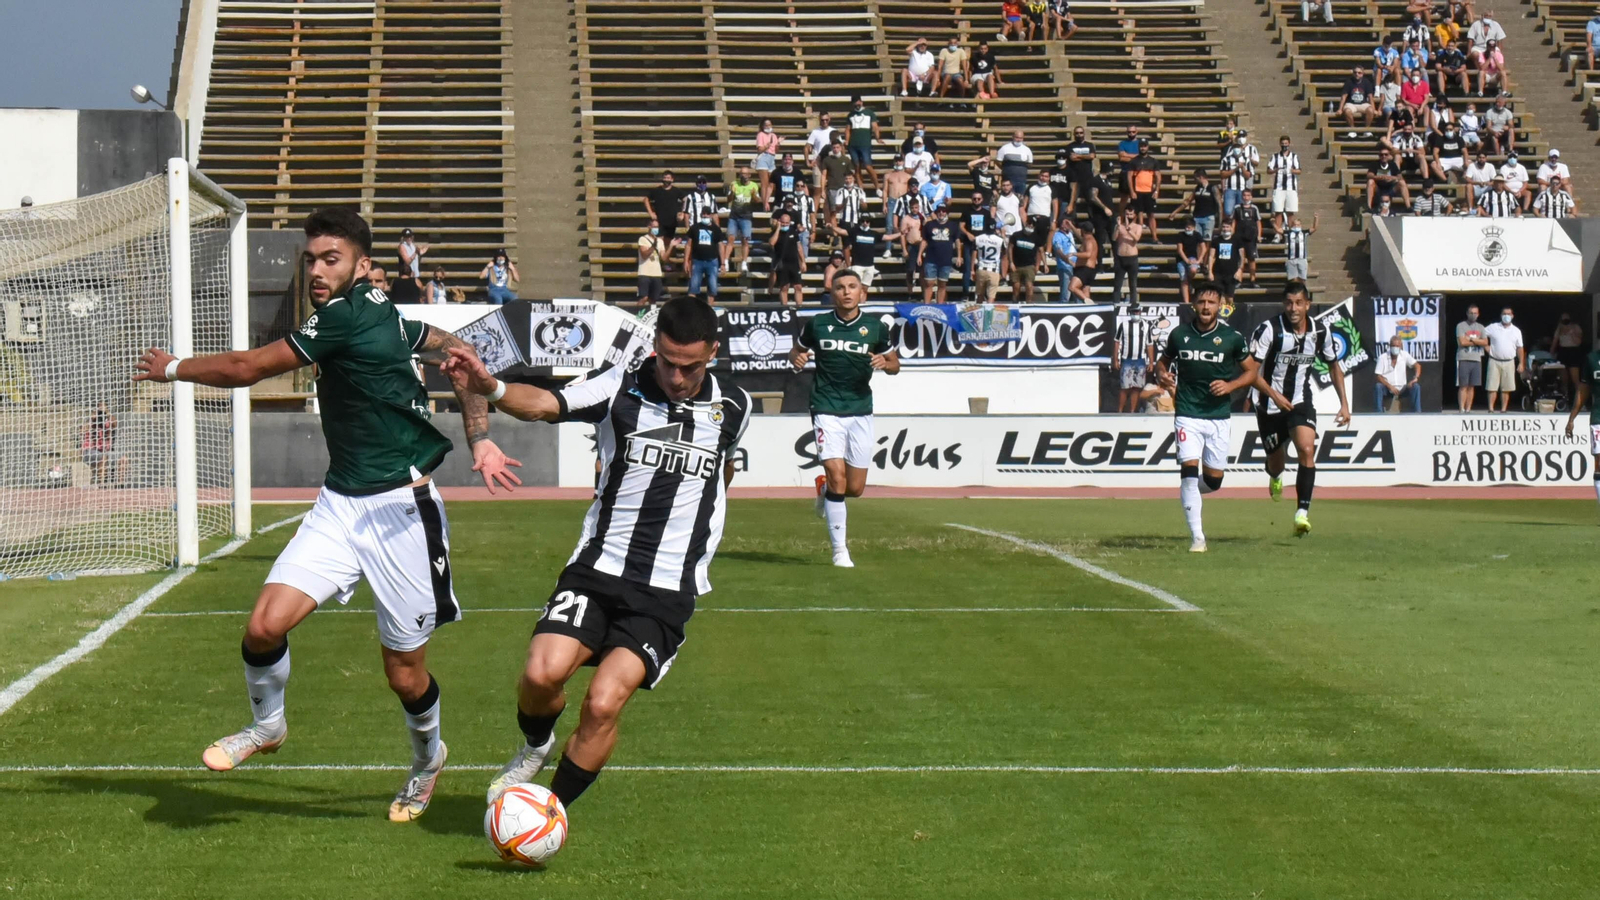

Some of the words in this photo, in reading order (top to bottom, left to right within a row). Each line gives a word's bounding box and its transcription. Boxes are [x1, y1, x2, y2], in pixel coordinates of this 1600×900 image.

[978, 245, 997, 261] 12
[1435, 267, 1449, 277] LA
[1452, 267, 1495, 277] BALONA
[1497, 266, 1523, 277] ESTÁ
[1524, 268, 1549, 277] VIVA
[1375, 297, 1437, 315] HIJOS
[728, 310, 791, 325] ULTRAS
[819, 339, 870, 354] DIGI
[1179, 350, 1224, 363] DIGI
[731, 361, 748, 371] NO
[749, 360, 794, 371] POLITICA
[1461, 419, 1542, 432] MUEBLES
[1550, 419, 1559, 432] Y
[1433, 434, 1588, 446] ELECTRODOMESTICOS
[624, 439, 718, 481] LOTUS
[1431, 450, 1588, 482] BARROSO
[548, 590, 589, 628] 21
